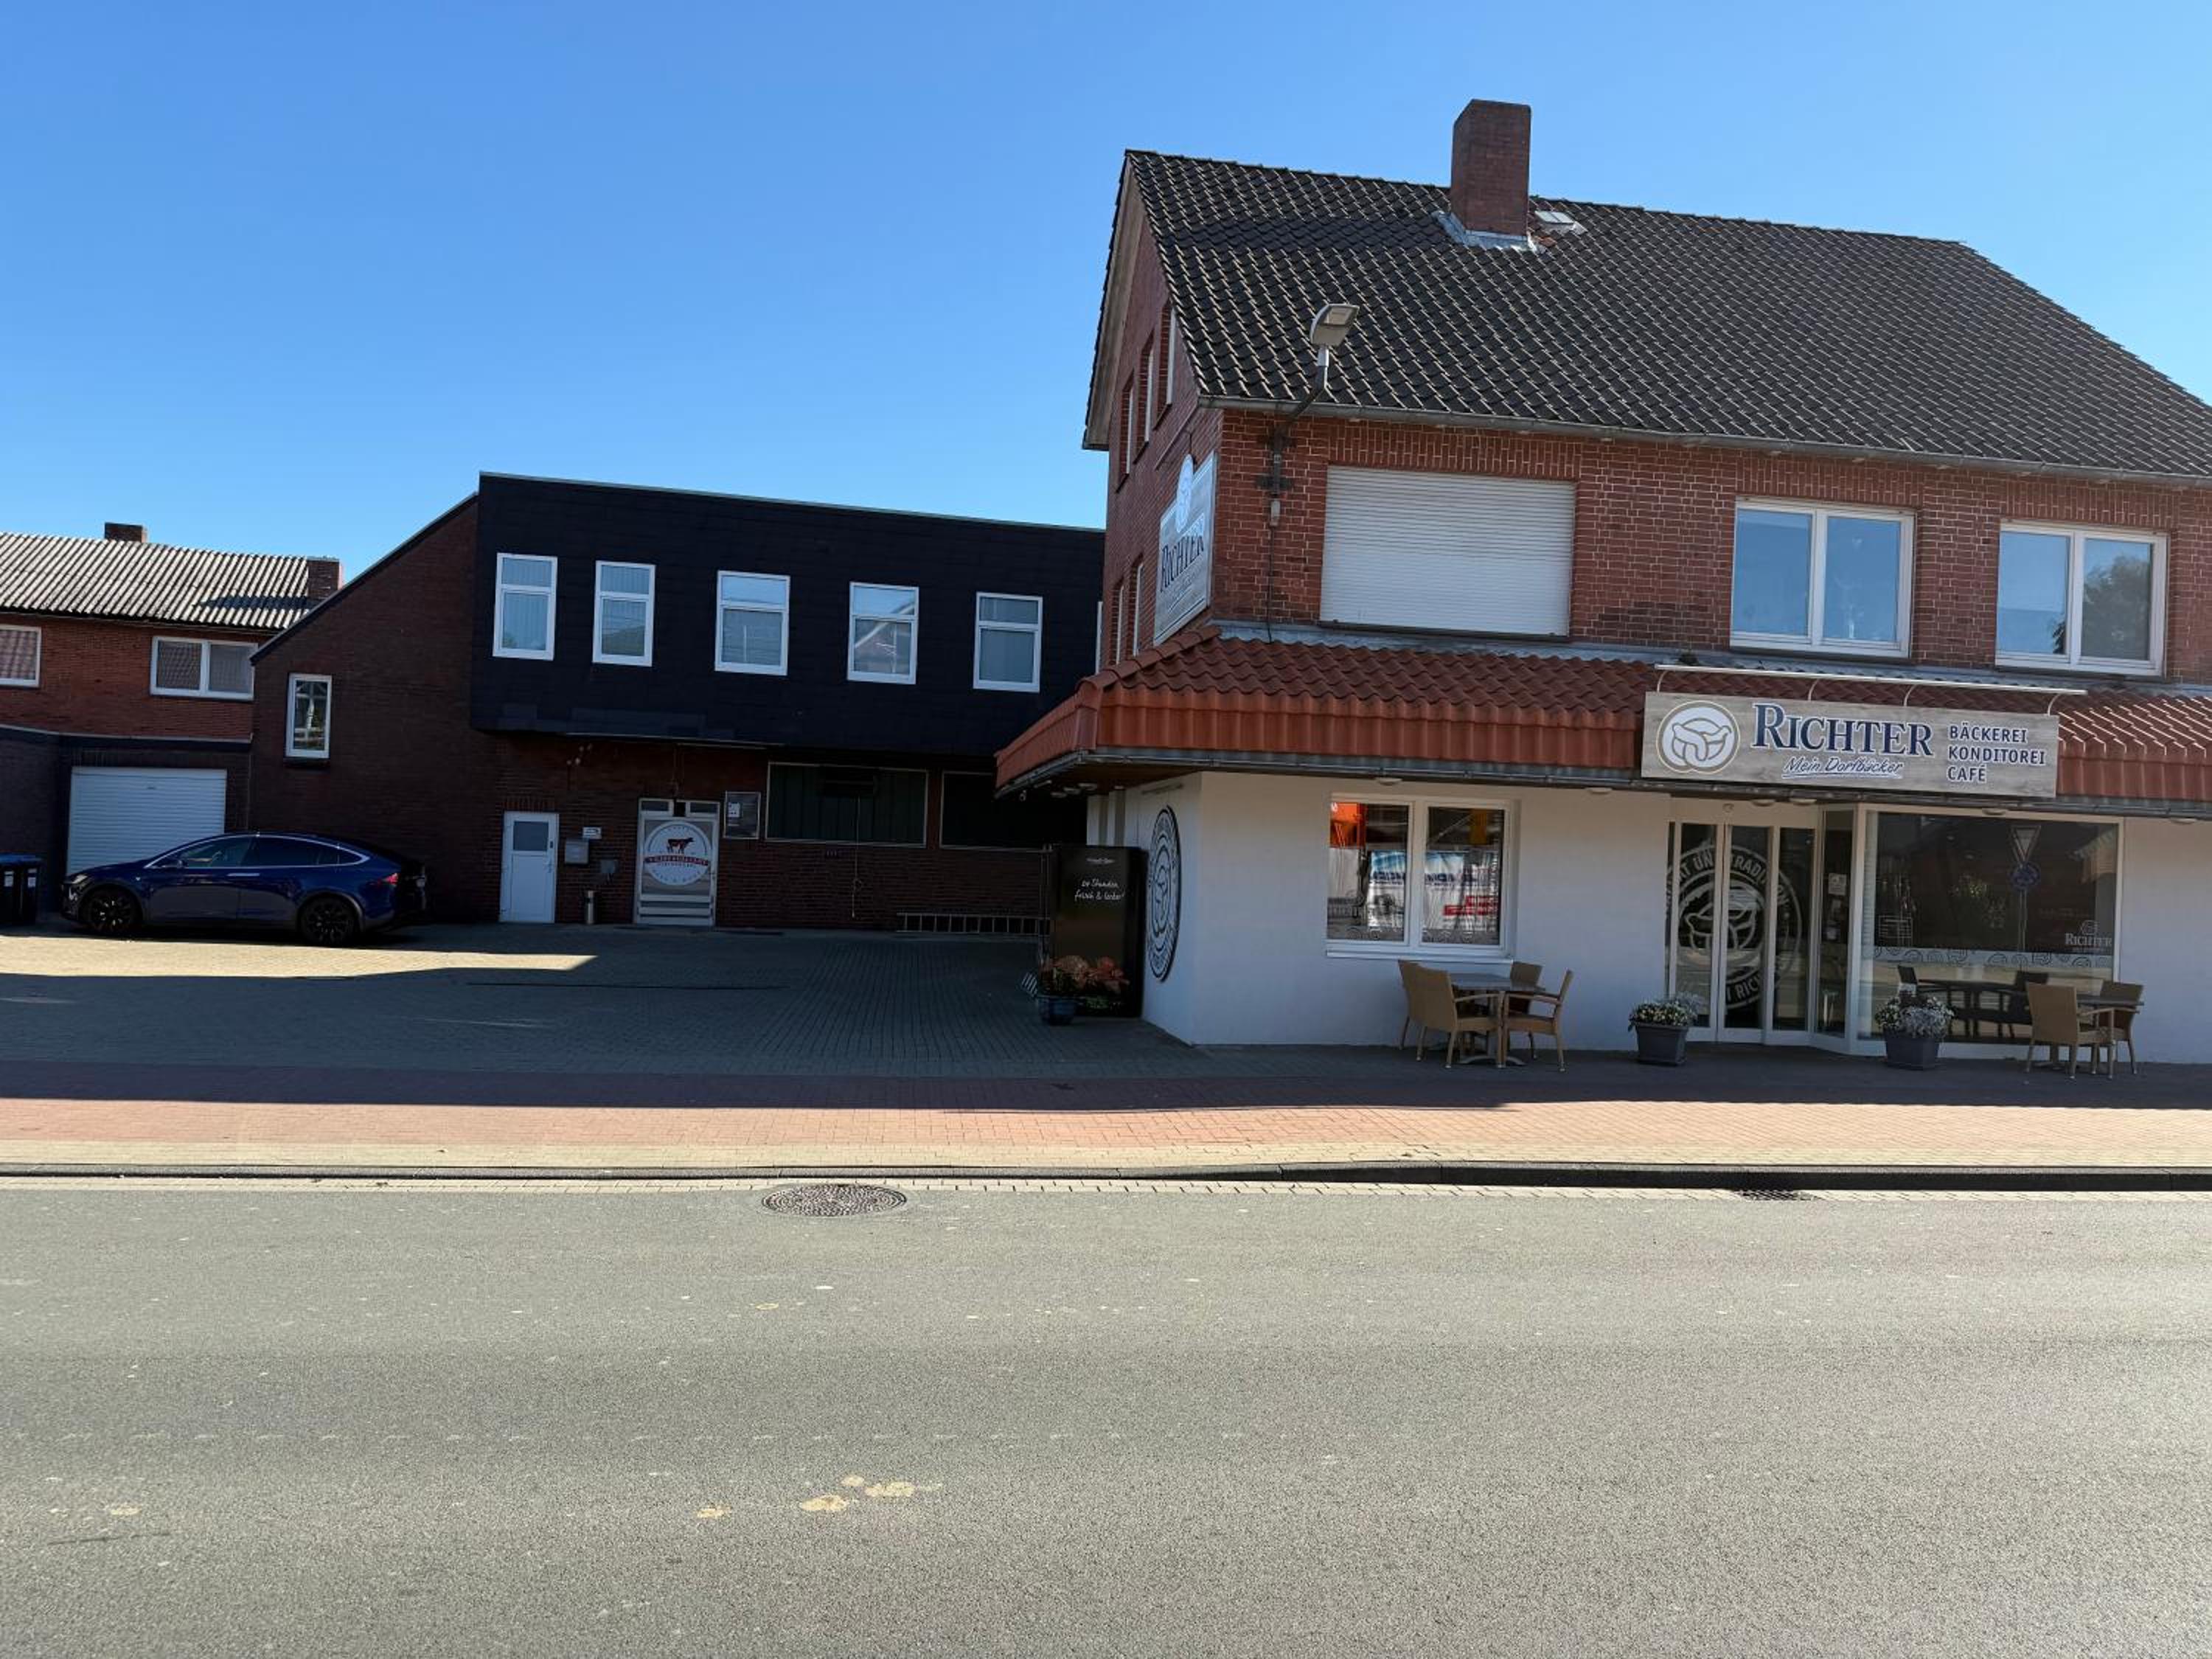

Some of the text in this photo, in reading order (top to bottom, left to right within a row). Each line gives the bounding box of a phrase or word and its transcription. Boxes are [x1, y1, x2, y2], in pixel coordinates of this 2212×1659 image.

[1161, 535, 1204, 593] RICHTER
[1752, 703, 1934, 757] RICHTER
[1949, 722, 2027, 743] BÄCKEREI
[1784, 757, 1903, 773] Mein Dorfbäcker
[1948, 745, 2045, 765] KONDITOREI
[1947, 764, 1986, 782] CAFÉ
